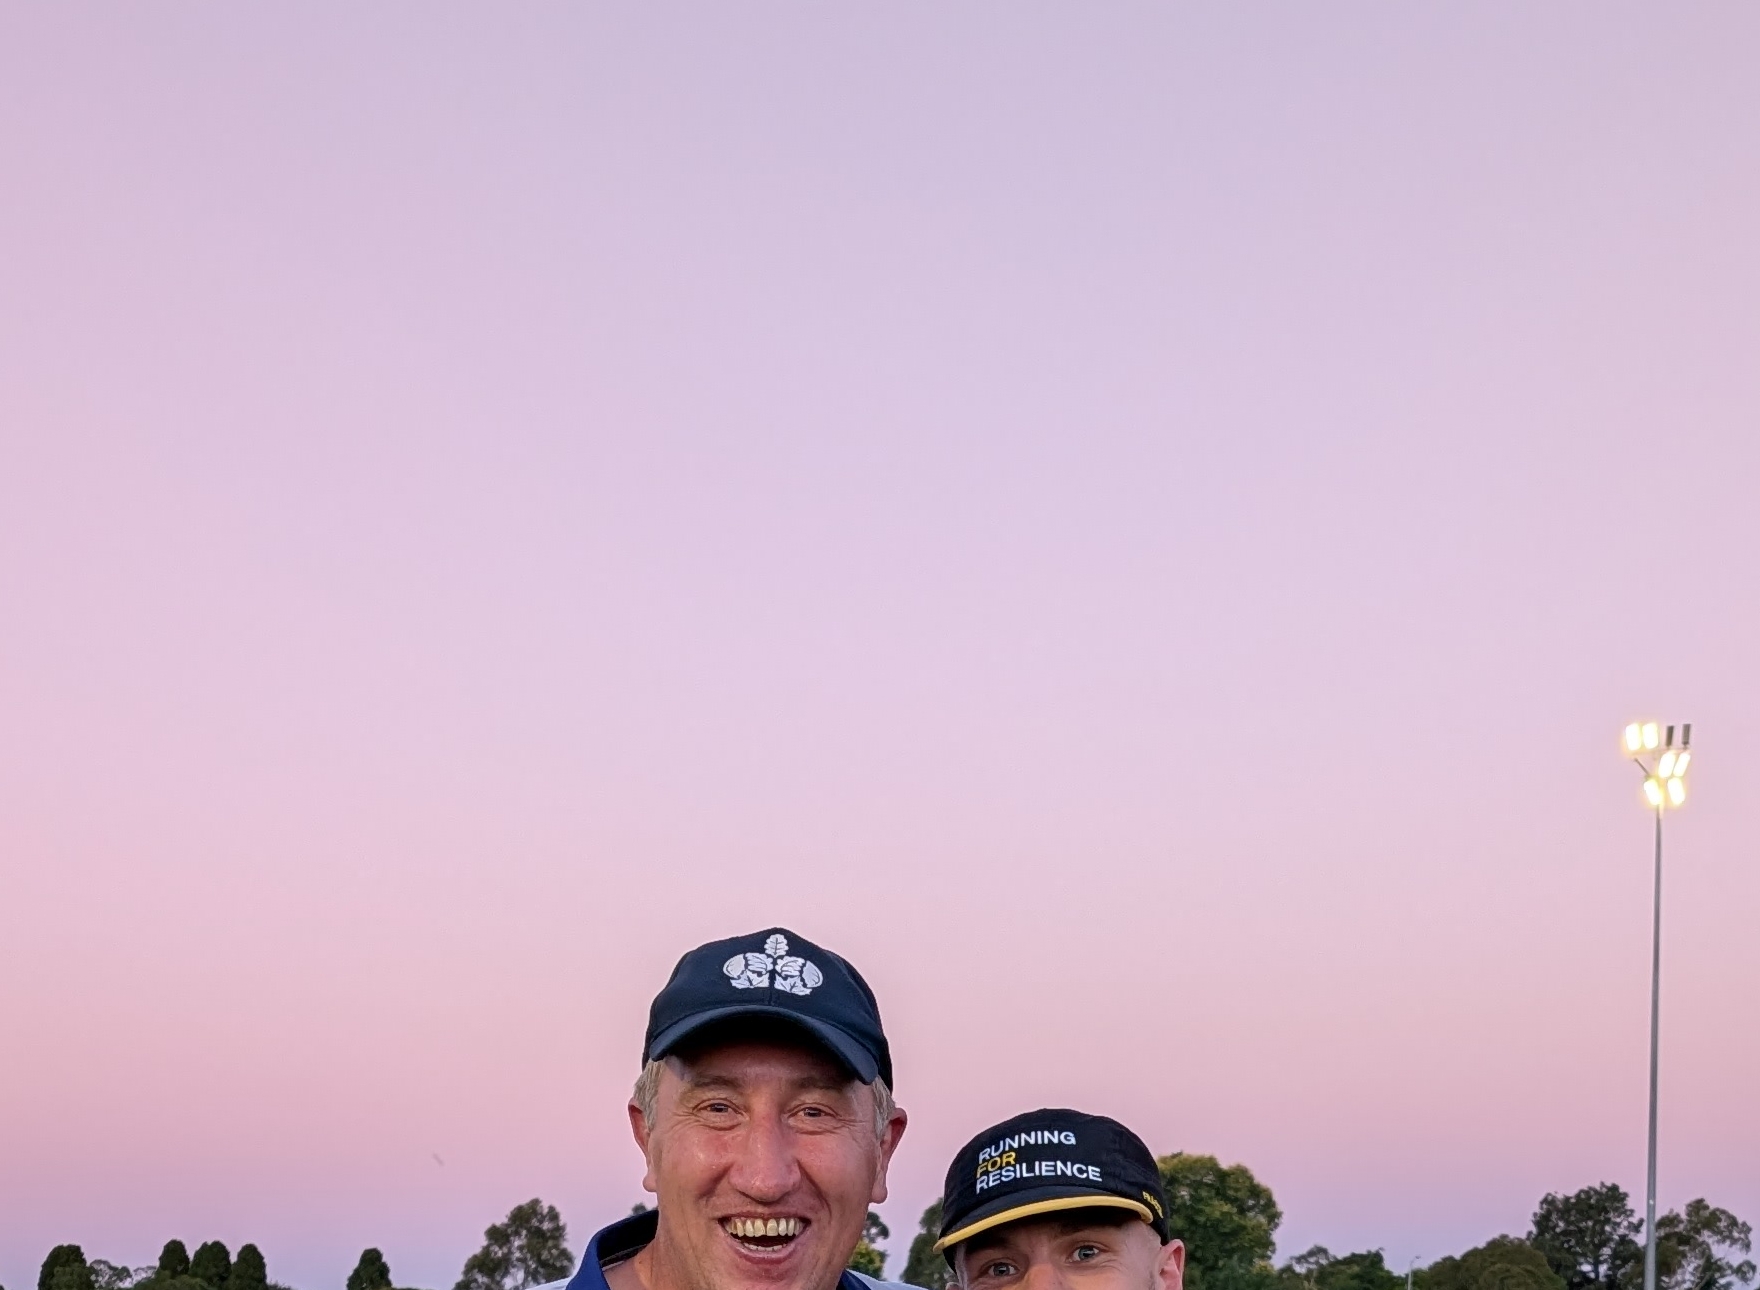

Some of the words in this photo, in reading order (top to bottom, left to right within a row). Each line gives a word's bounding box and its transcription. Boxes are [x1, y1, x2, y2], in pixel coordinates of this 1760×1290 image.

[979, 1131, 1077, 1164] RUNNING
[976, 1151, 1017, 1178] FOR
[976, 1160, 1103, 1194] RESILIENCE
